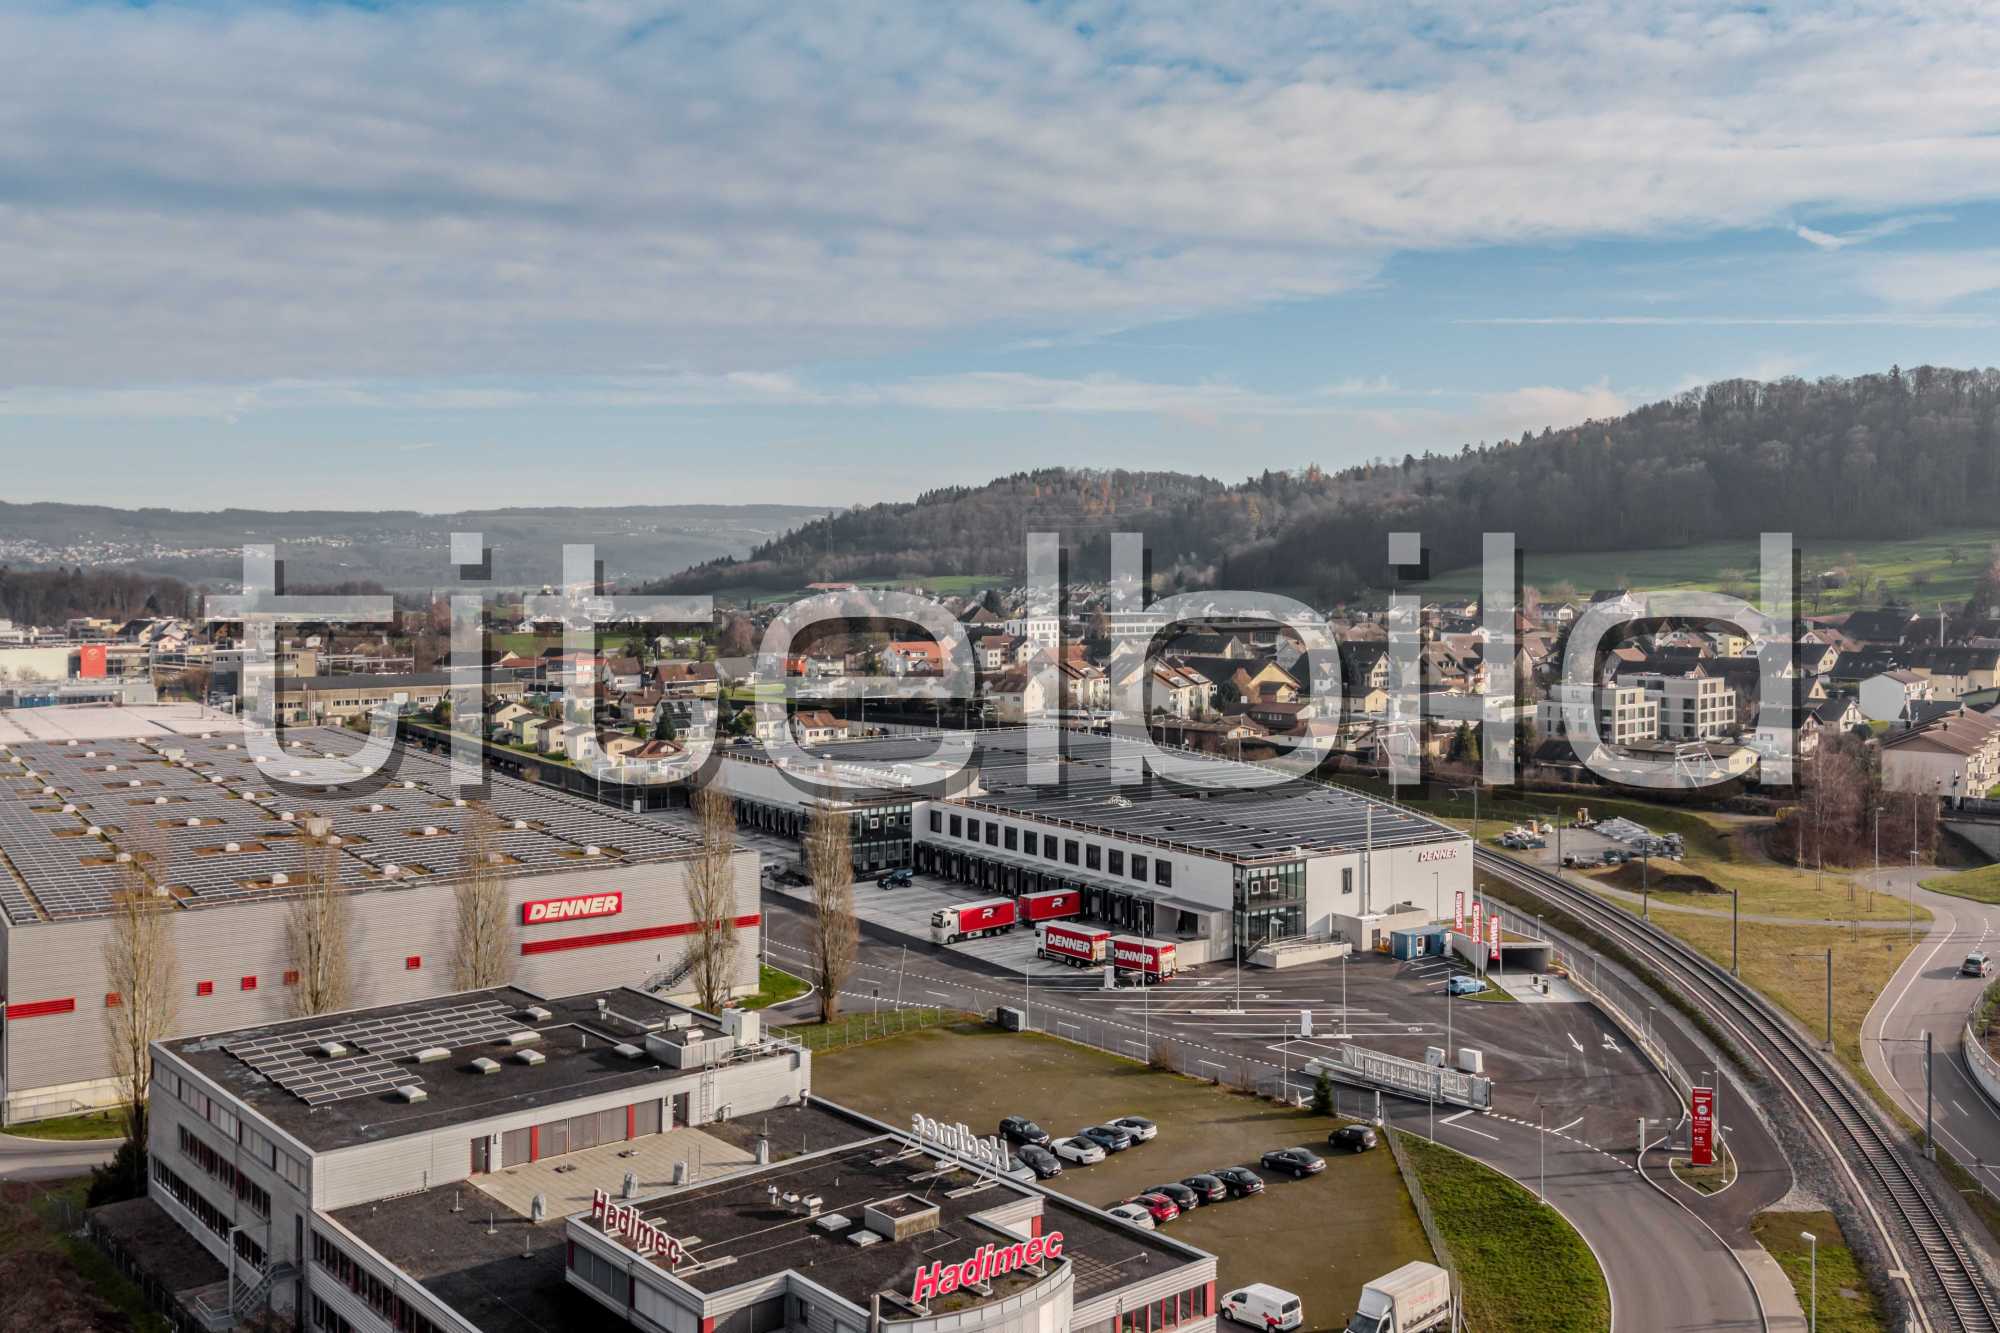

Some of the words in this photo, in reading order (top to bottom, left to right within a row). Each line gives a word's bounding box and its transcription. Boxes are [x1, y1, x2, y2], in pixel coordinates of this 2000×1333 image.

[1418, 849, 1457, 862] DENNER
[529, 896, 618, 920] DENNER
[1048, 933, 1091, 954] DENNER
[592, 1187, 682, 1264] Hadimec
[912, 1231, 1064, 1304] Hadimec
